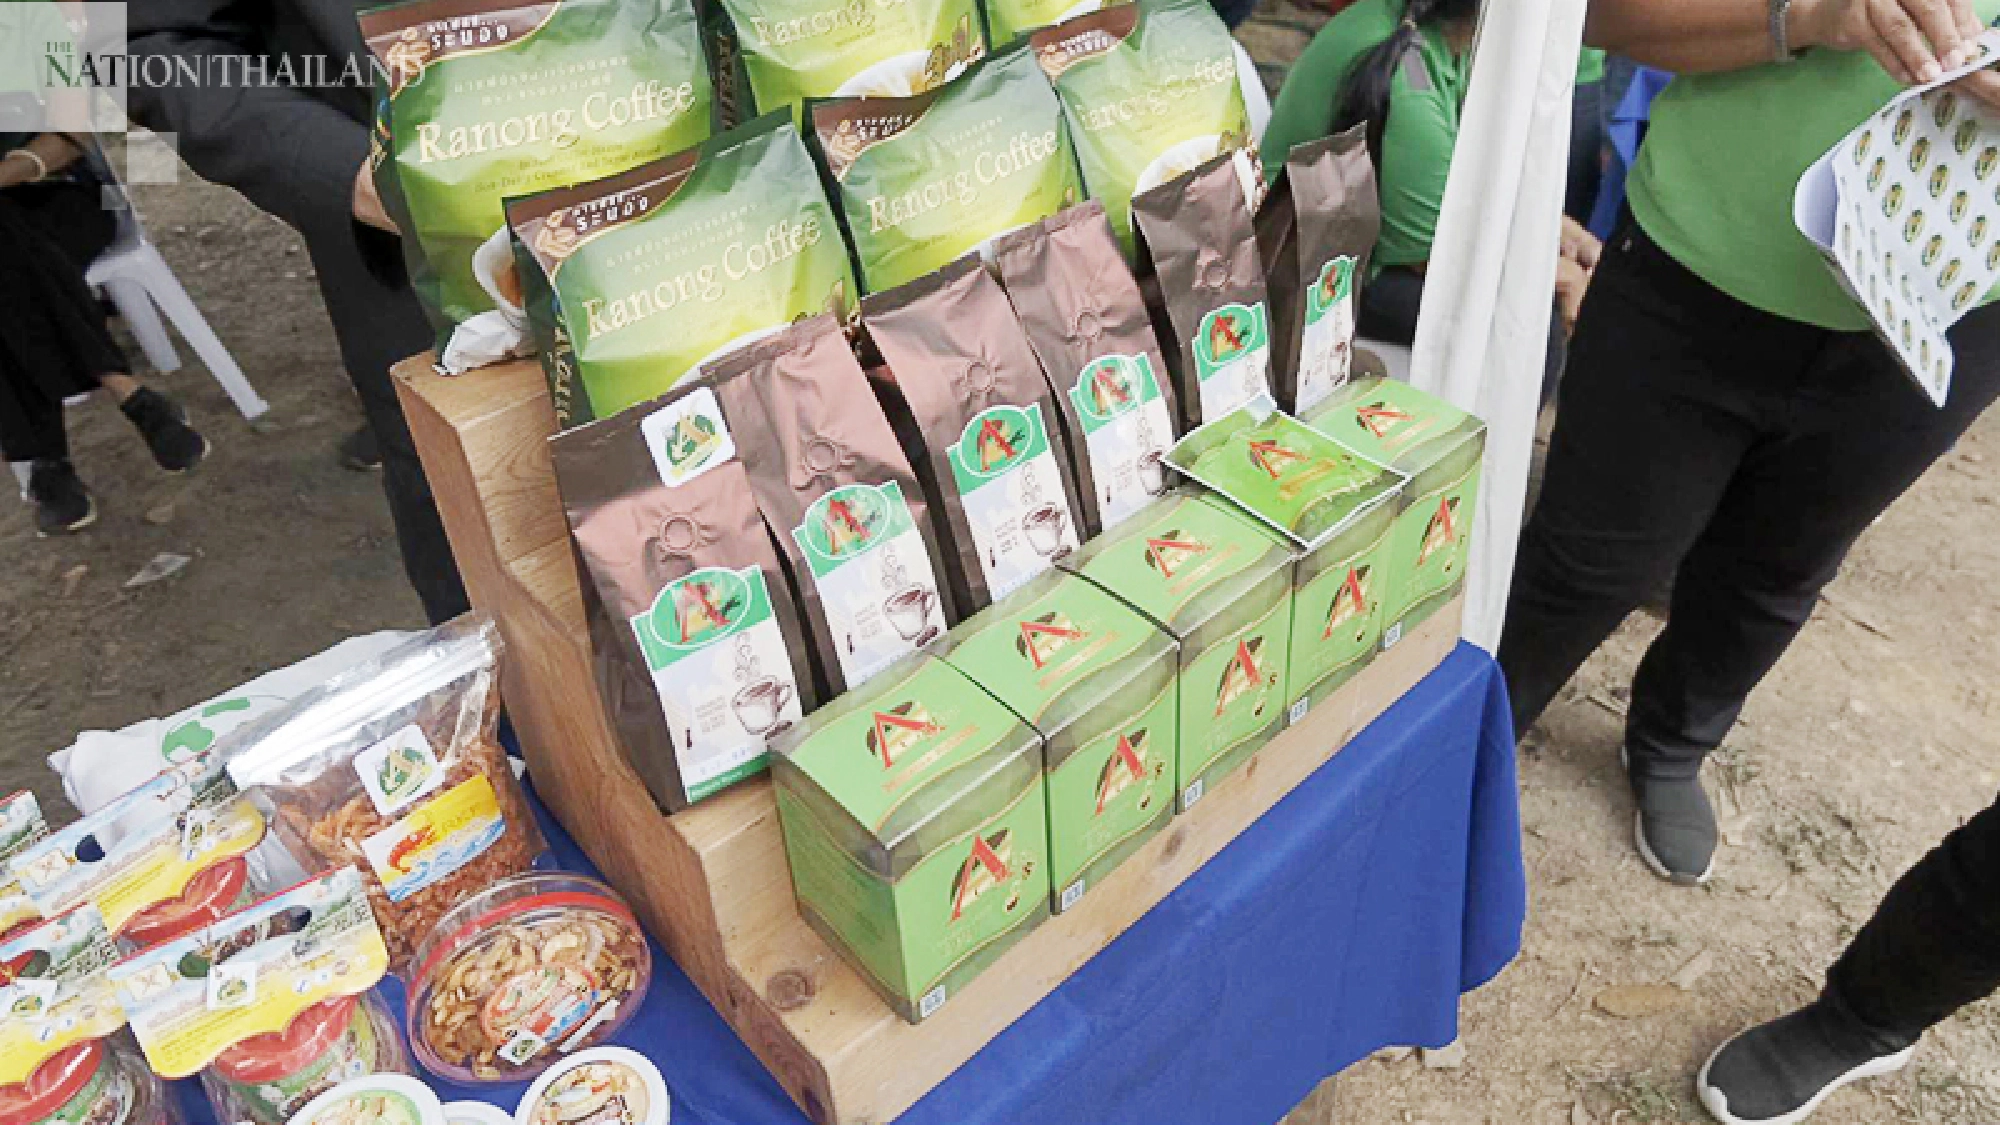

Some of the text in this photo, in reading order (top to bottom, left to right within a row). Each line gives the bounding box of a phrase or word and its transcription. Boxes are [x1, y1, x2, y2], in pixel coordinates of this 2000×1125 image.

[415, 108, 580, 164] Ranong
[582, 80, 696, 132] Coffee
[866, 168, 979, 235] Ranong
[974, 130, 1058, 186] Coffee
[581, 264, 726, 341] Ranong
[723, 213, 822, 281] Coffee
